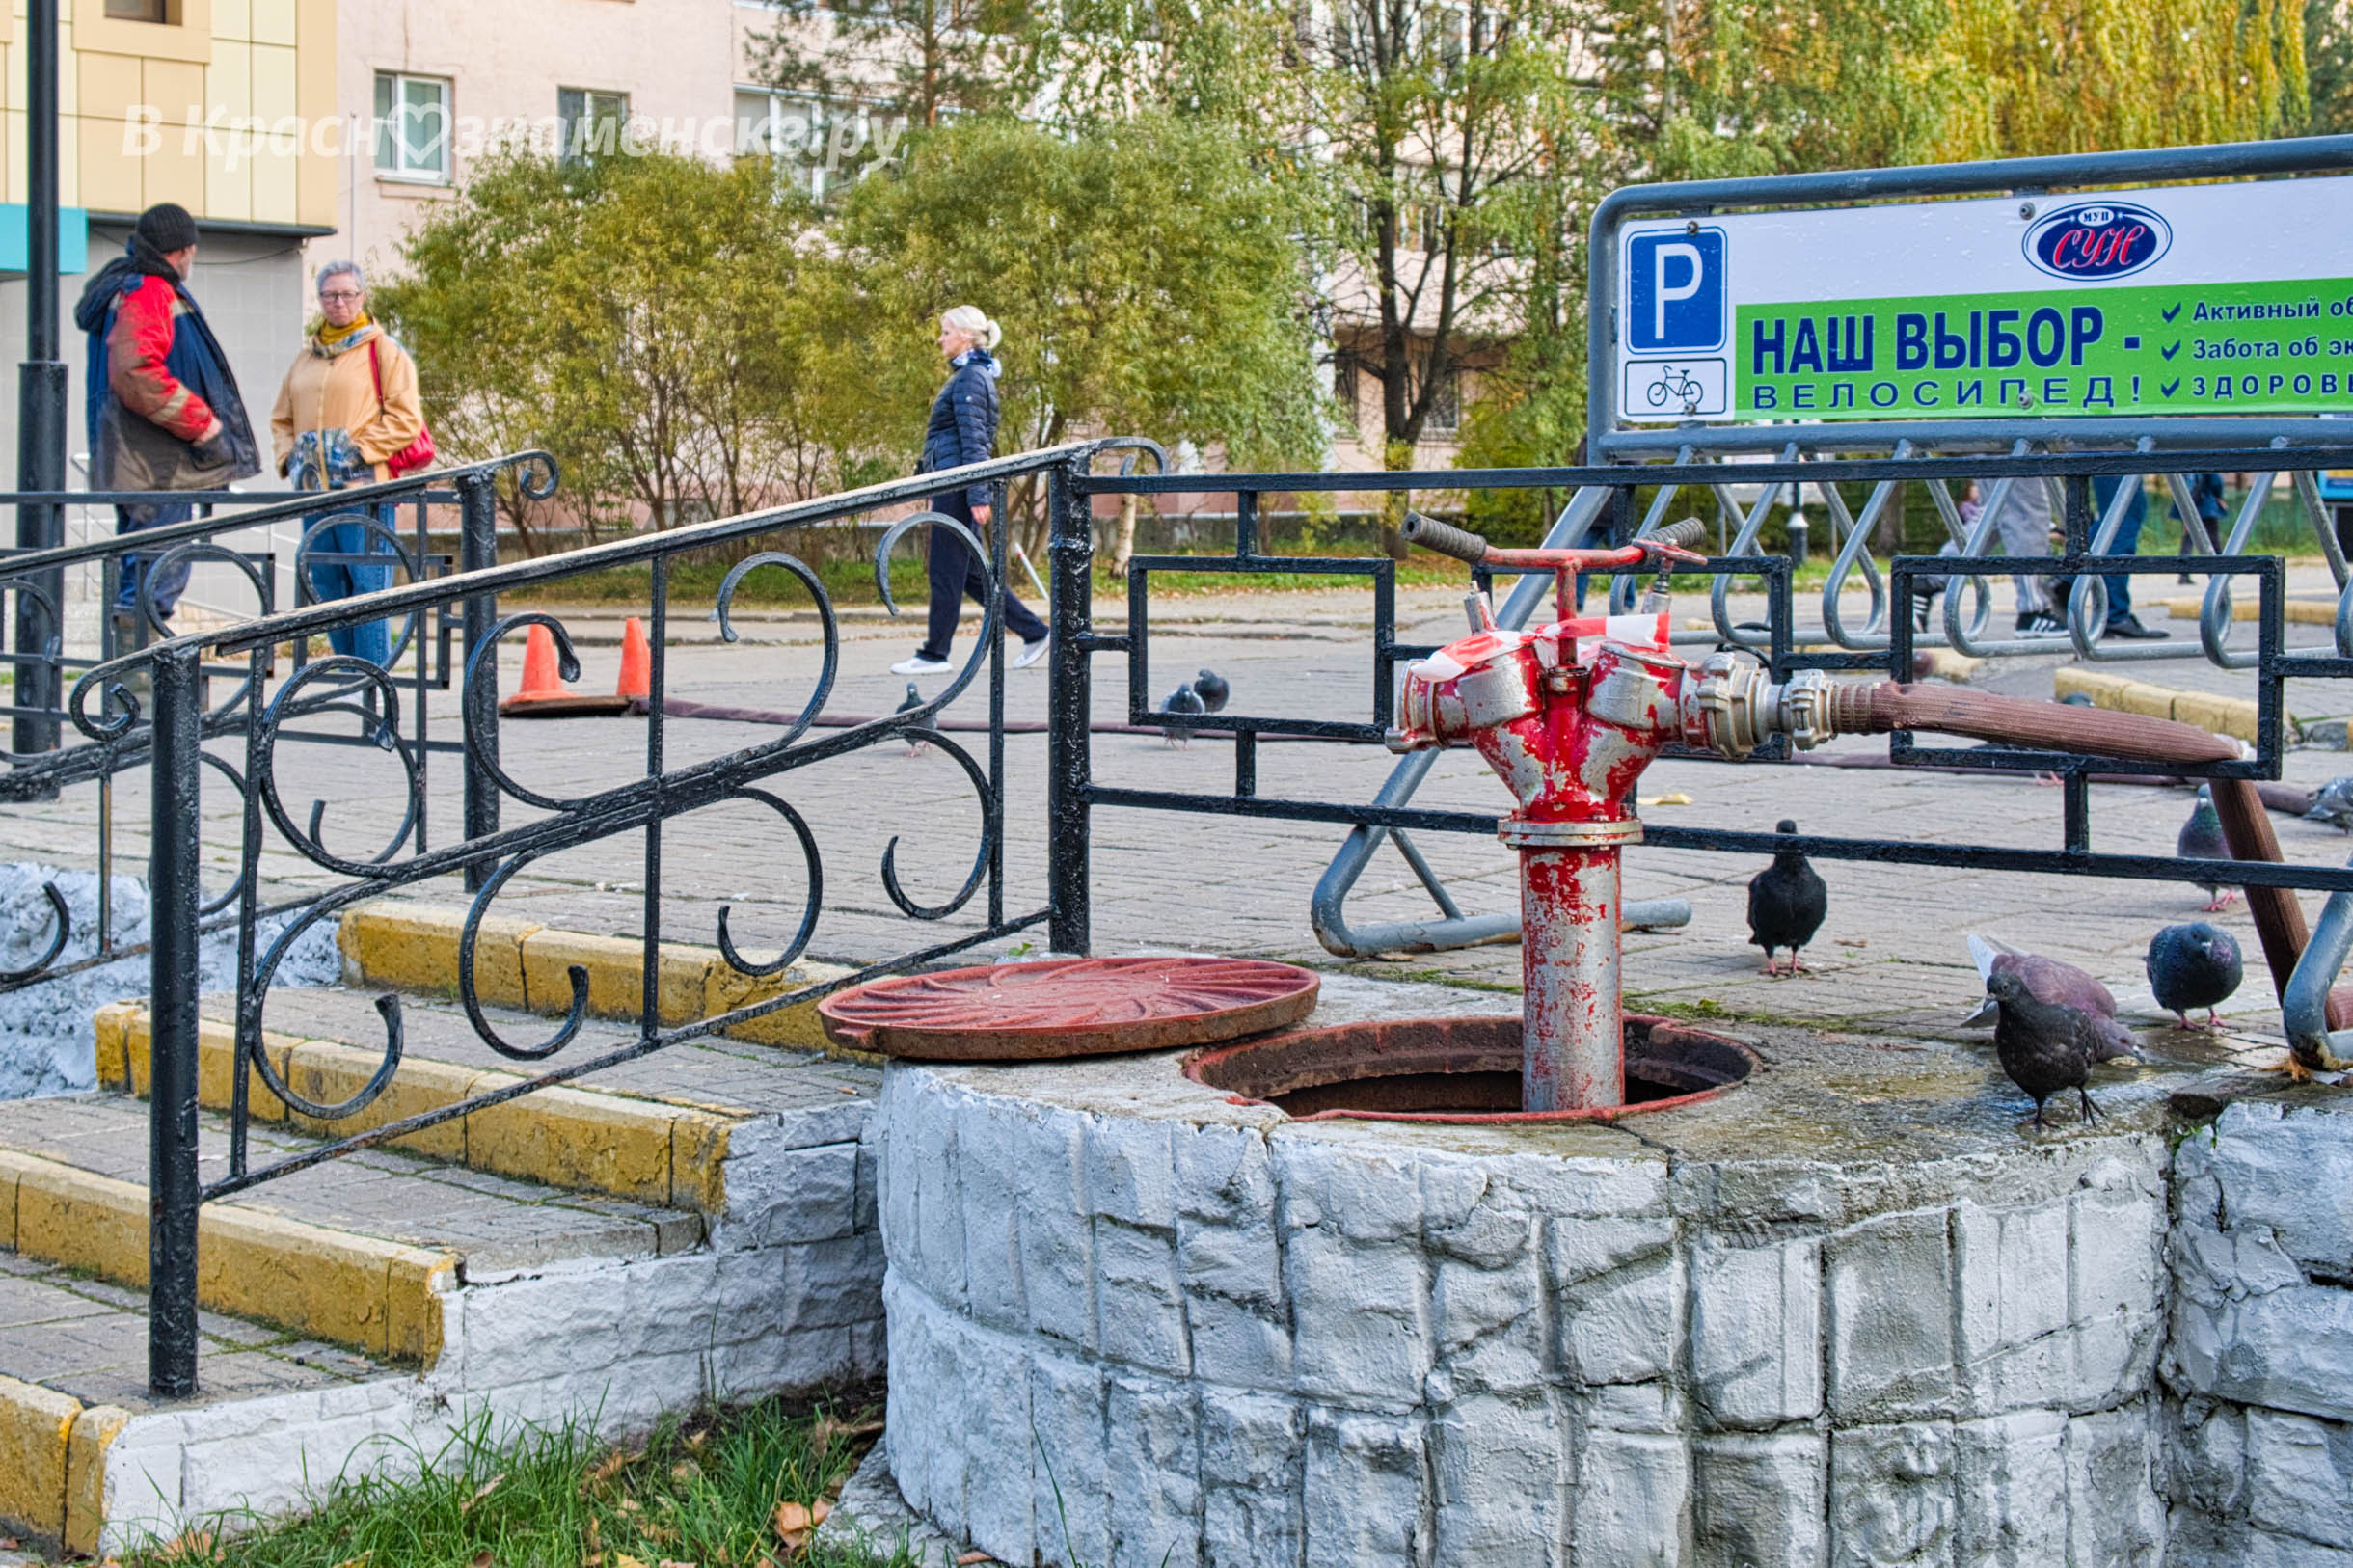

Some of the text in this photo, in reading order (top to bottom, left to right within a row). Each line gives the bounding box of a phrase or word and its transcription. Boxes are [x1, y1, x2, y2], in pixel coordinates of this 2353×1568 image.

[2084, 211, 2109, 222] МУП
[1655, 243, 1703, 339] P
[2193, 296, 2320, 321] Активный
[1753, 315, 1874, 375] НАШ
[1895, 306, 2103, 371] ВЫБОР
[2193, 338, 2279, 359] Забота
[2288, 336, 2318, 357] об
[1753, 376, 2141, 410] ВЕЛОСИПЕД!
